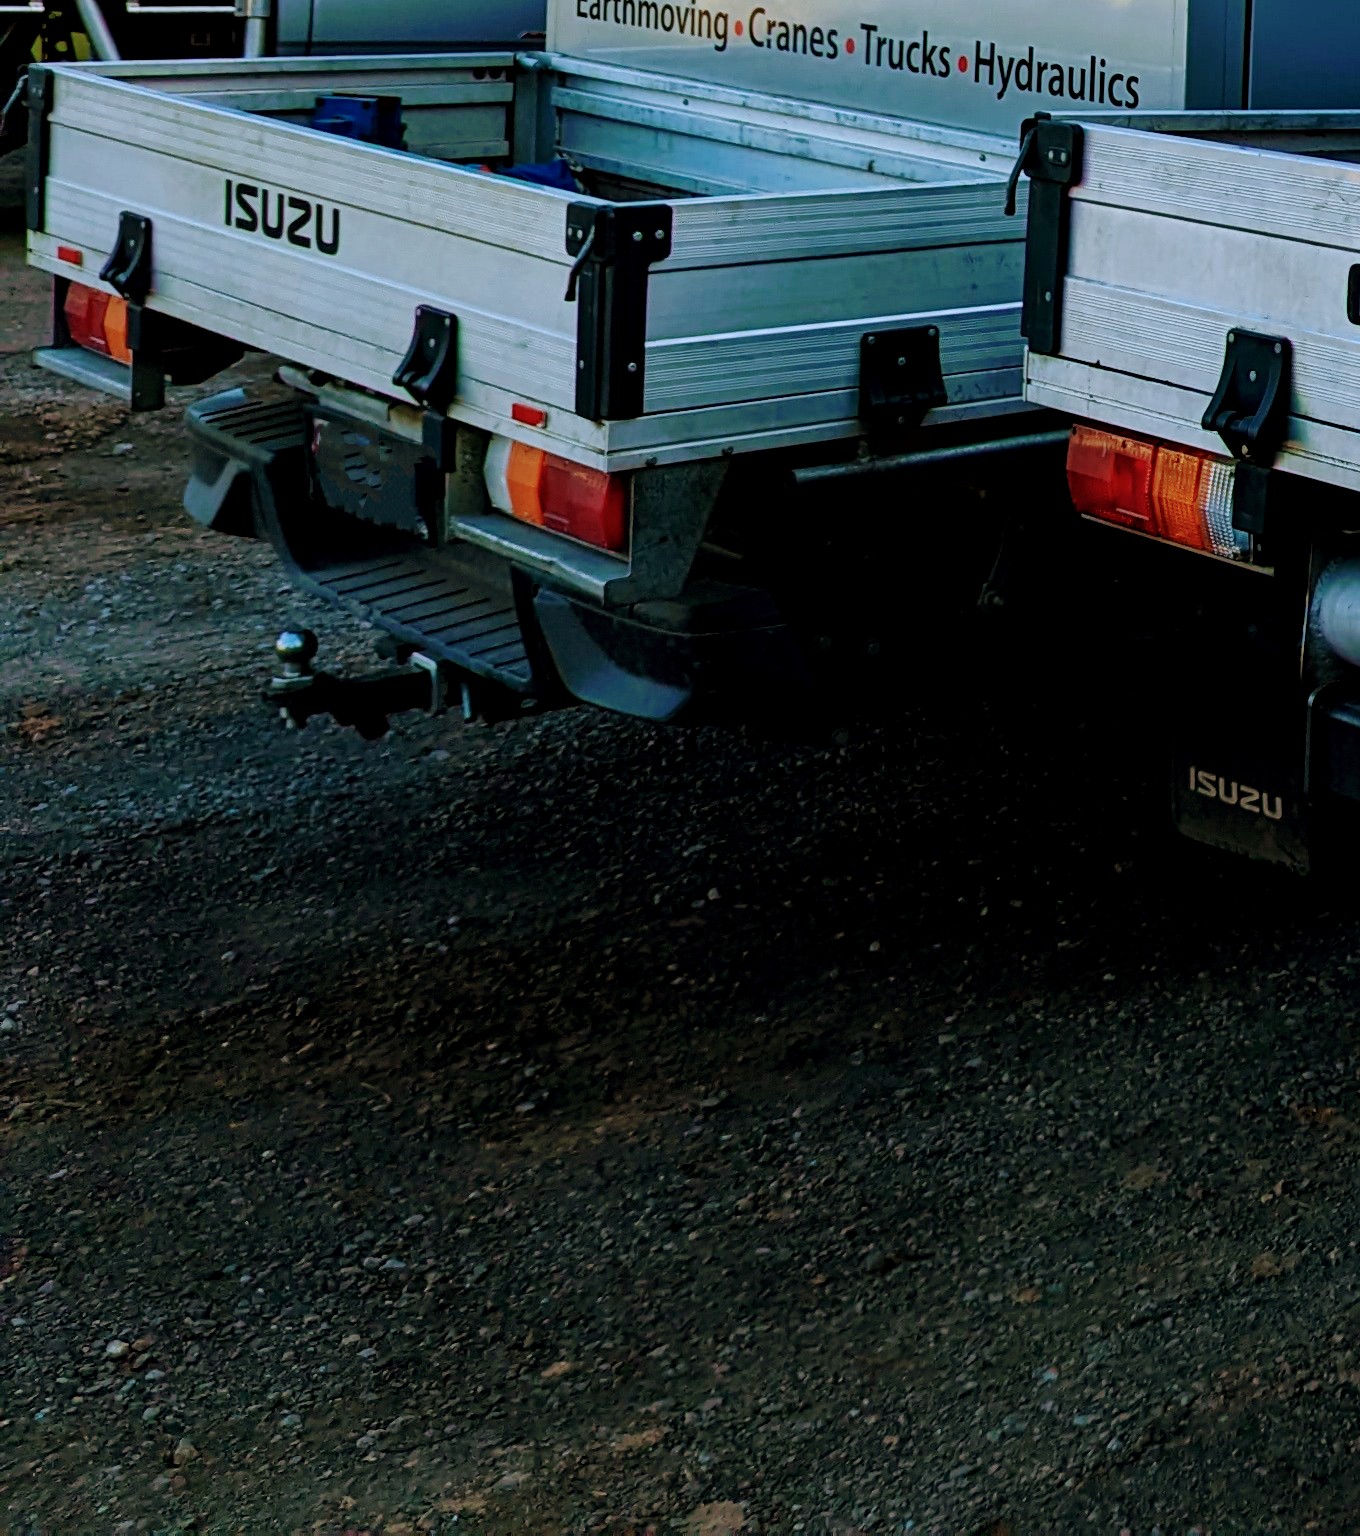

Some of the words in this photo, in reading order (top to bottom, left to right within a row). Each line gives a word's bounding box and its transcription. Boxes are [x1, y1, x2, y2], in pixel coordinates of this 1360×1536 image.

[748, 7, 838, 59] Cranes
[860, 23, 951, 78] Trucks
[974, 41, 1140, 110] Hydraulics
[225, 179, 340, 255] ISUZU
[1189, 766, 1283, 820] ISUZU
